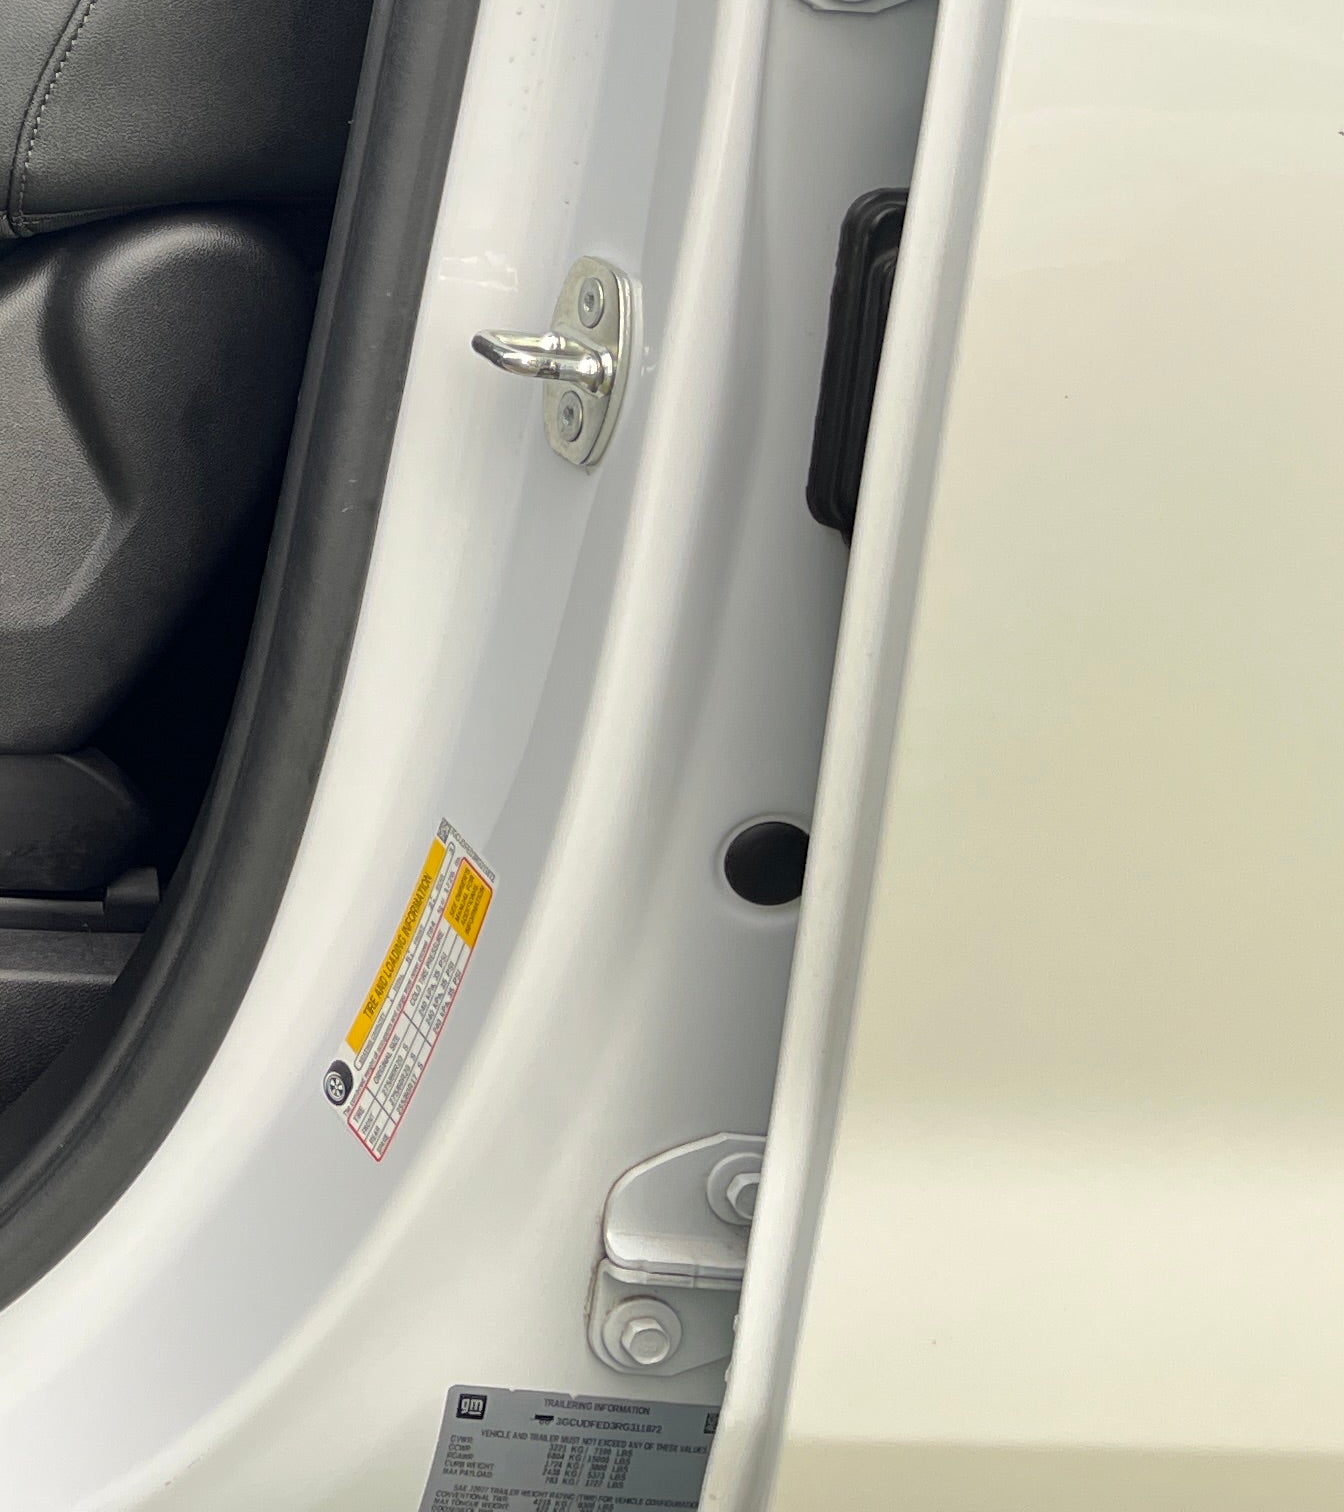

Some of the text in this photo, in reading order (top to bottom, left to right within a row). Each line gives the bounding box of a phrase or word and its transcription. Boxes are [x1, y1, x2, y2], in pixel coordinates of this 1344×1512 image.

[363, 995, 379, 1019] TIRE
[375, 975, 388, 999] AND
[384, 933, 406, 976] LOADING
[402, 872, 432, 936] INFORMATION
[461, 1398, 484, 1415] gm
[544, 1398, 651, 1415] TRAILERING INFORMATION
